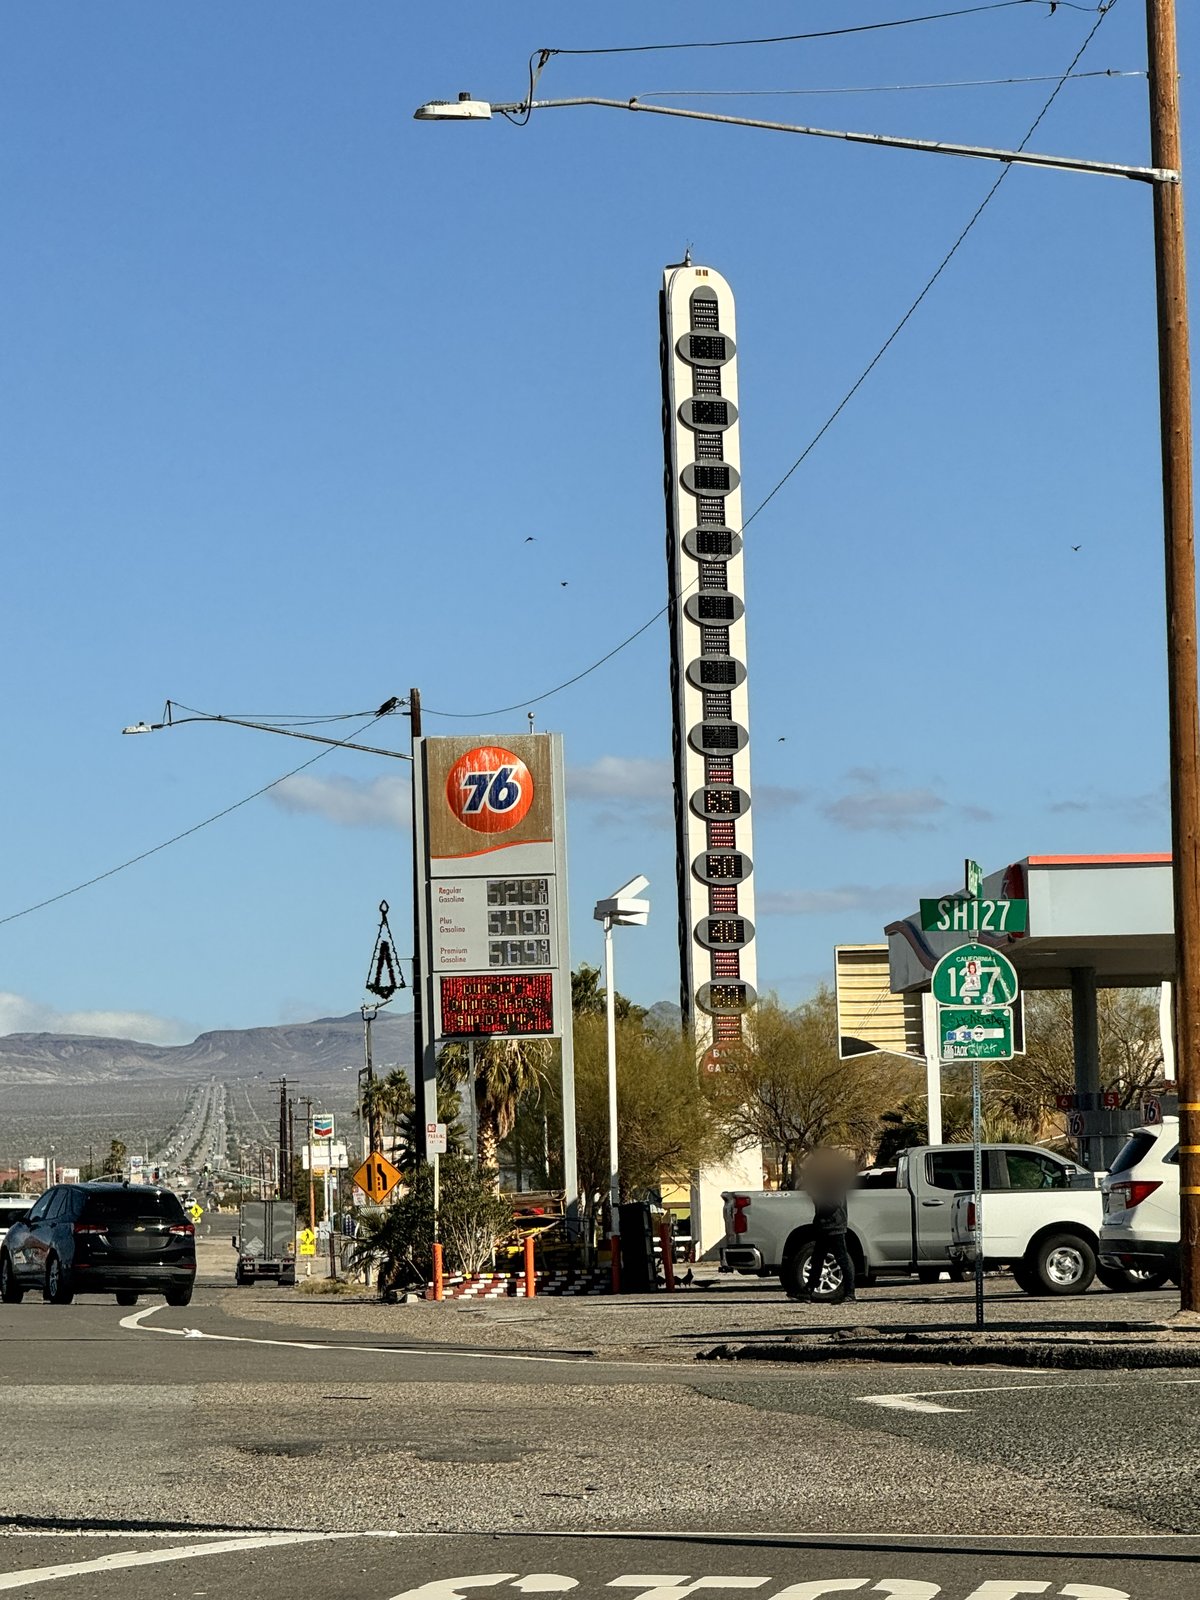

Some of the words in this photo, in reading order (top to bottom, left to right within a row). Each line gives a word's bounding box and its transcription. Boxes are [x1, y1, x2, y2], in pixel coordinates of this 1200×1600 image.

[460, 765, 522, 813] 76
[707, 791, 733, 812] 65
[709, 855, 734, 877] 50
[438, 886, 462, 895] Regular
[439, 917, 453, 925] Plus
[937, 900, 1011, 931] SH127
[711, 920, 737, 943] 40
[440, 947, 468, 955] Premium
[947, 967, 1001, 997] 127
[713, 985, 739, 1008] 30
